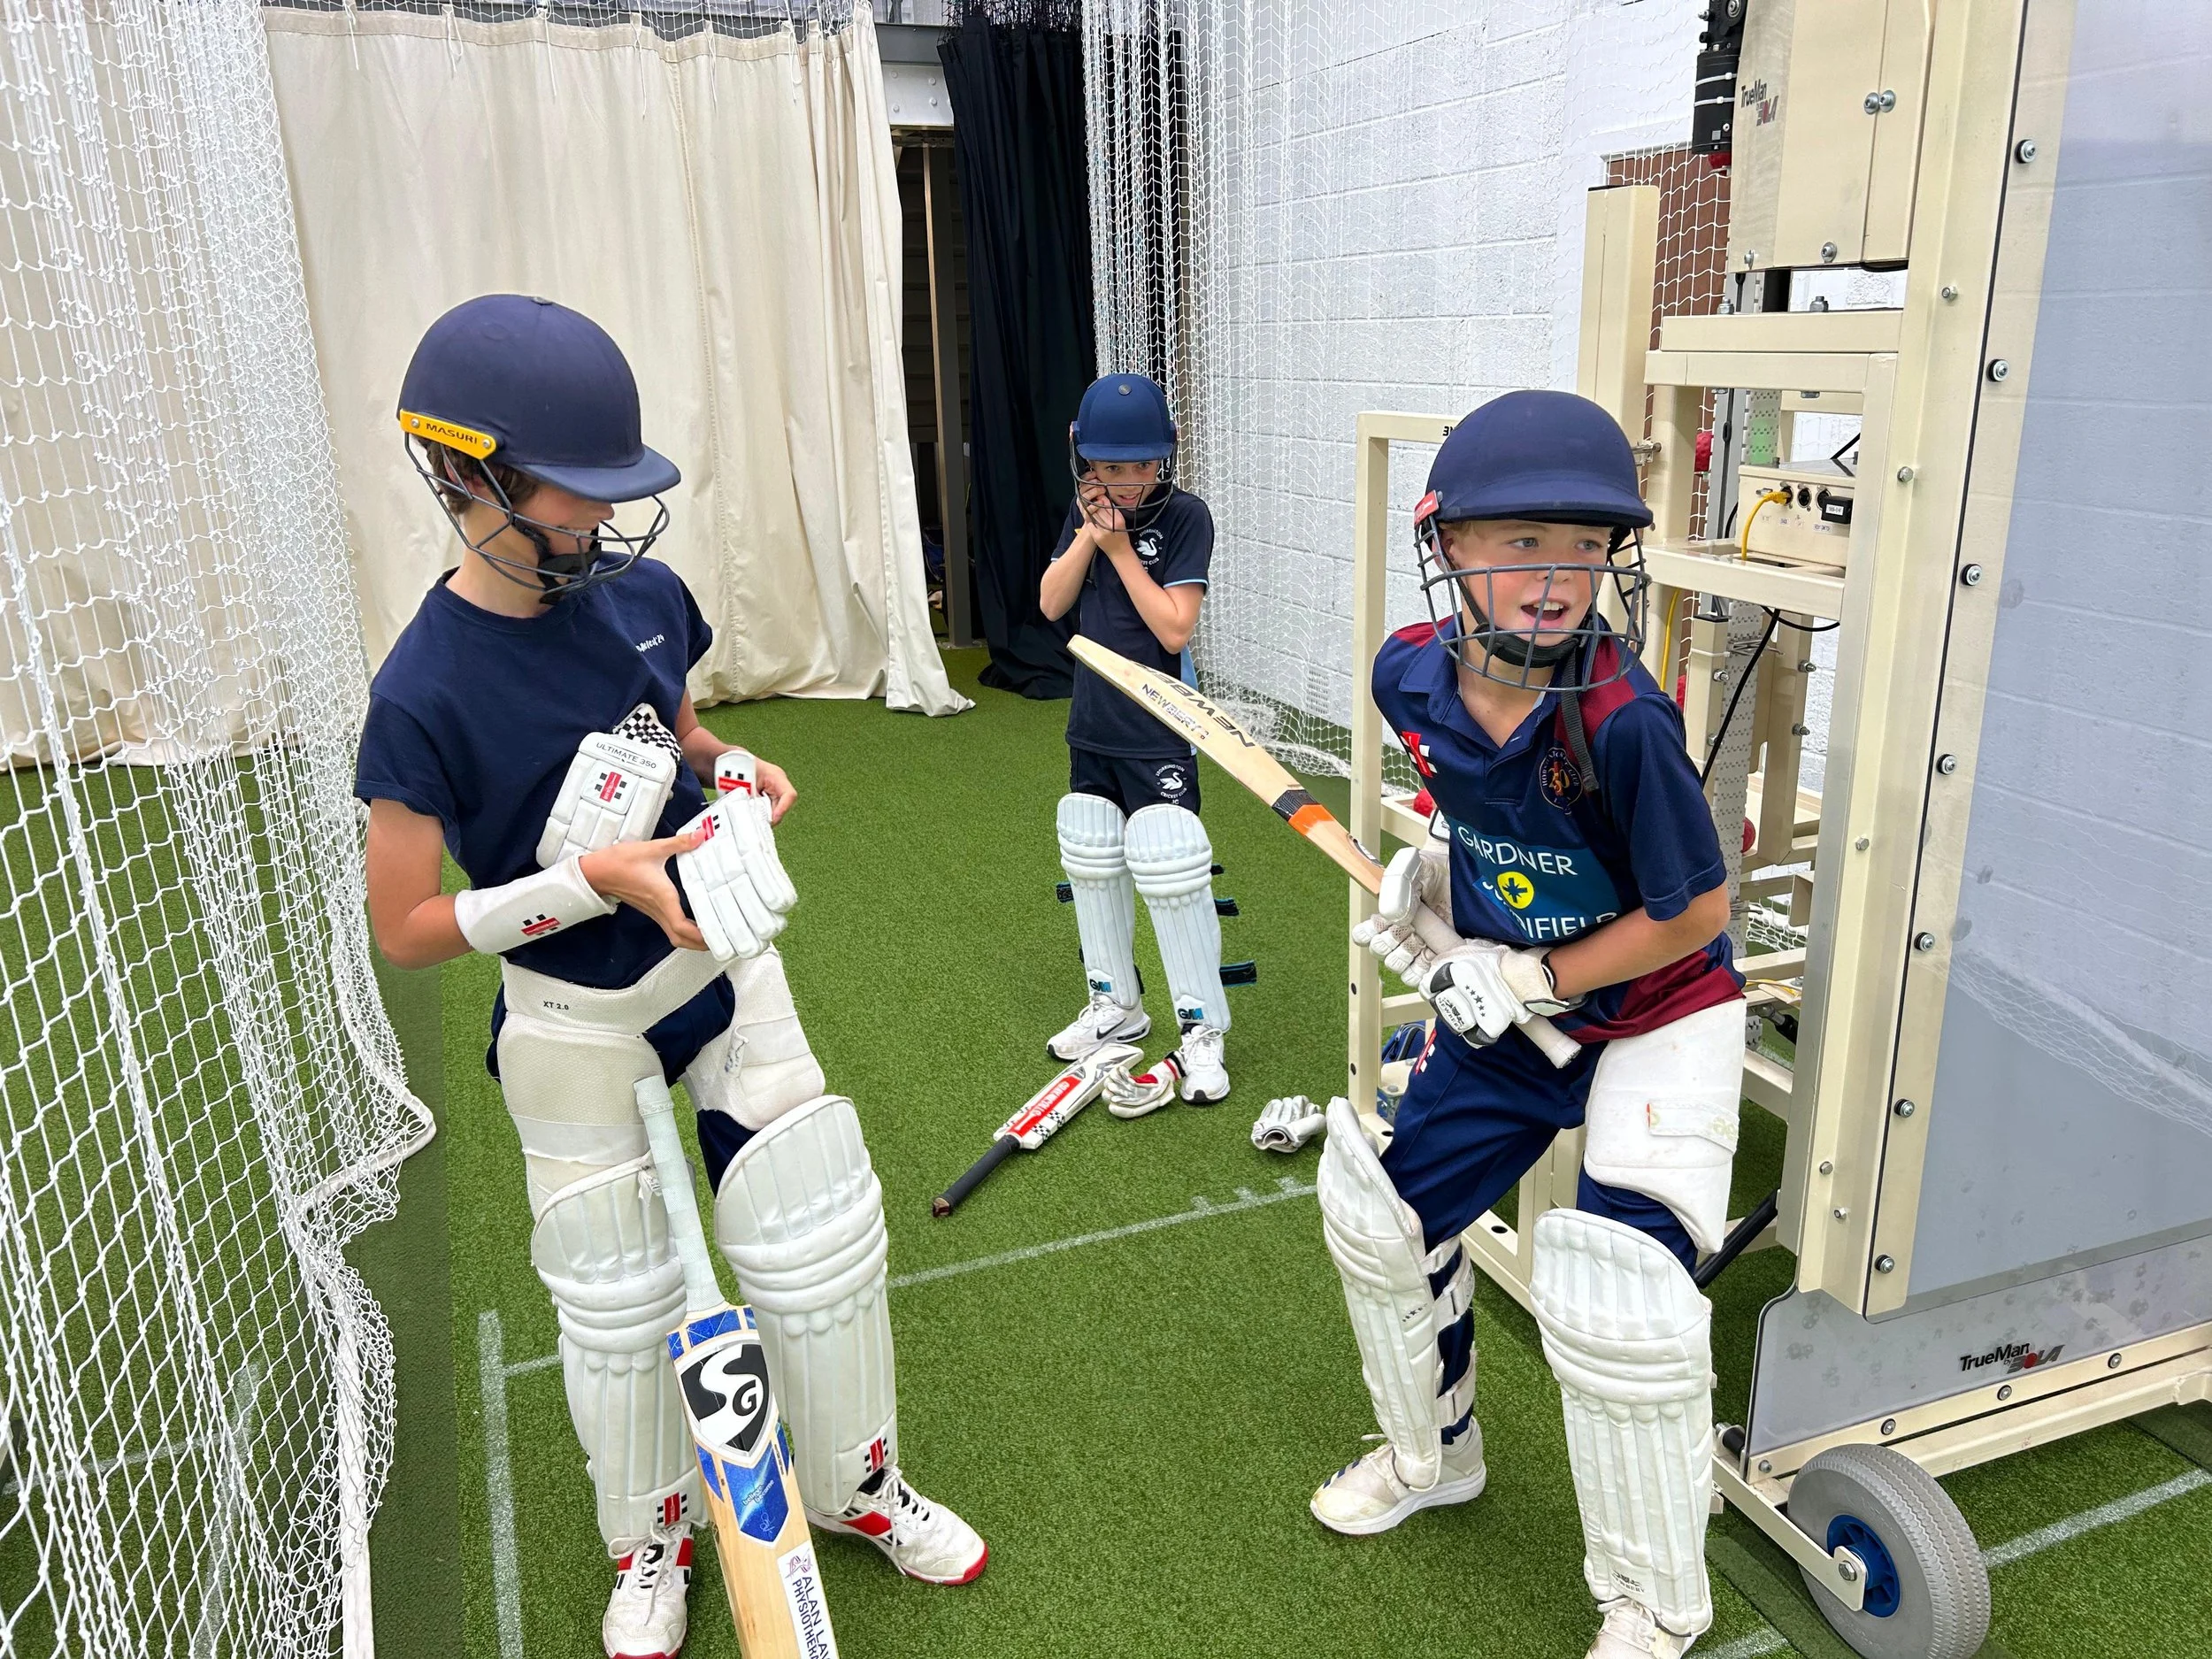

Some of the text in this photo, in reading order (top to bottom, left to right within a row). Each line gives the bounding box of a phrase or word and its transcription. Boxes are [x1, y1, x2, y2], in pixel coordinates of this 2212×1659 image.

[426, 423, 478, 444] MASURI
[596, 742, 657, 769] ULTIMATE 350
[1457, 826, 1578, 875] GARDNER
[1960, 1343, 2031, 1371] TrueMan
[685, 1343, 769, 1454] SG
[802, 1576, 823, 1626] ALAN
